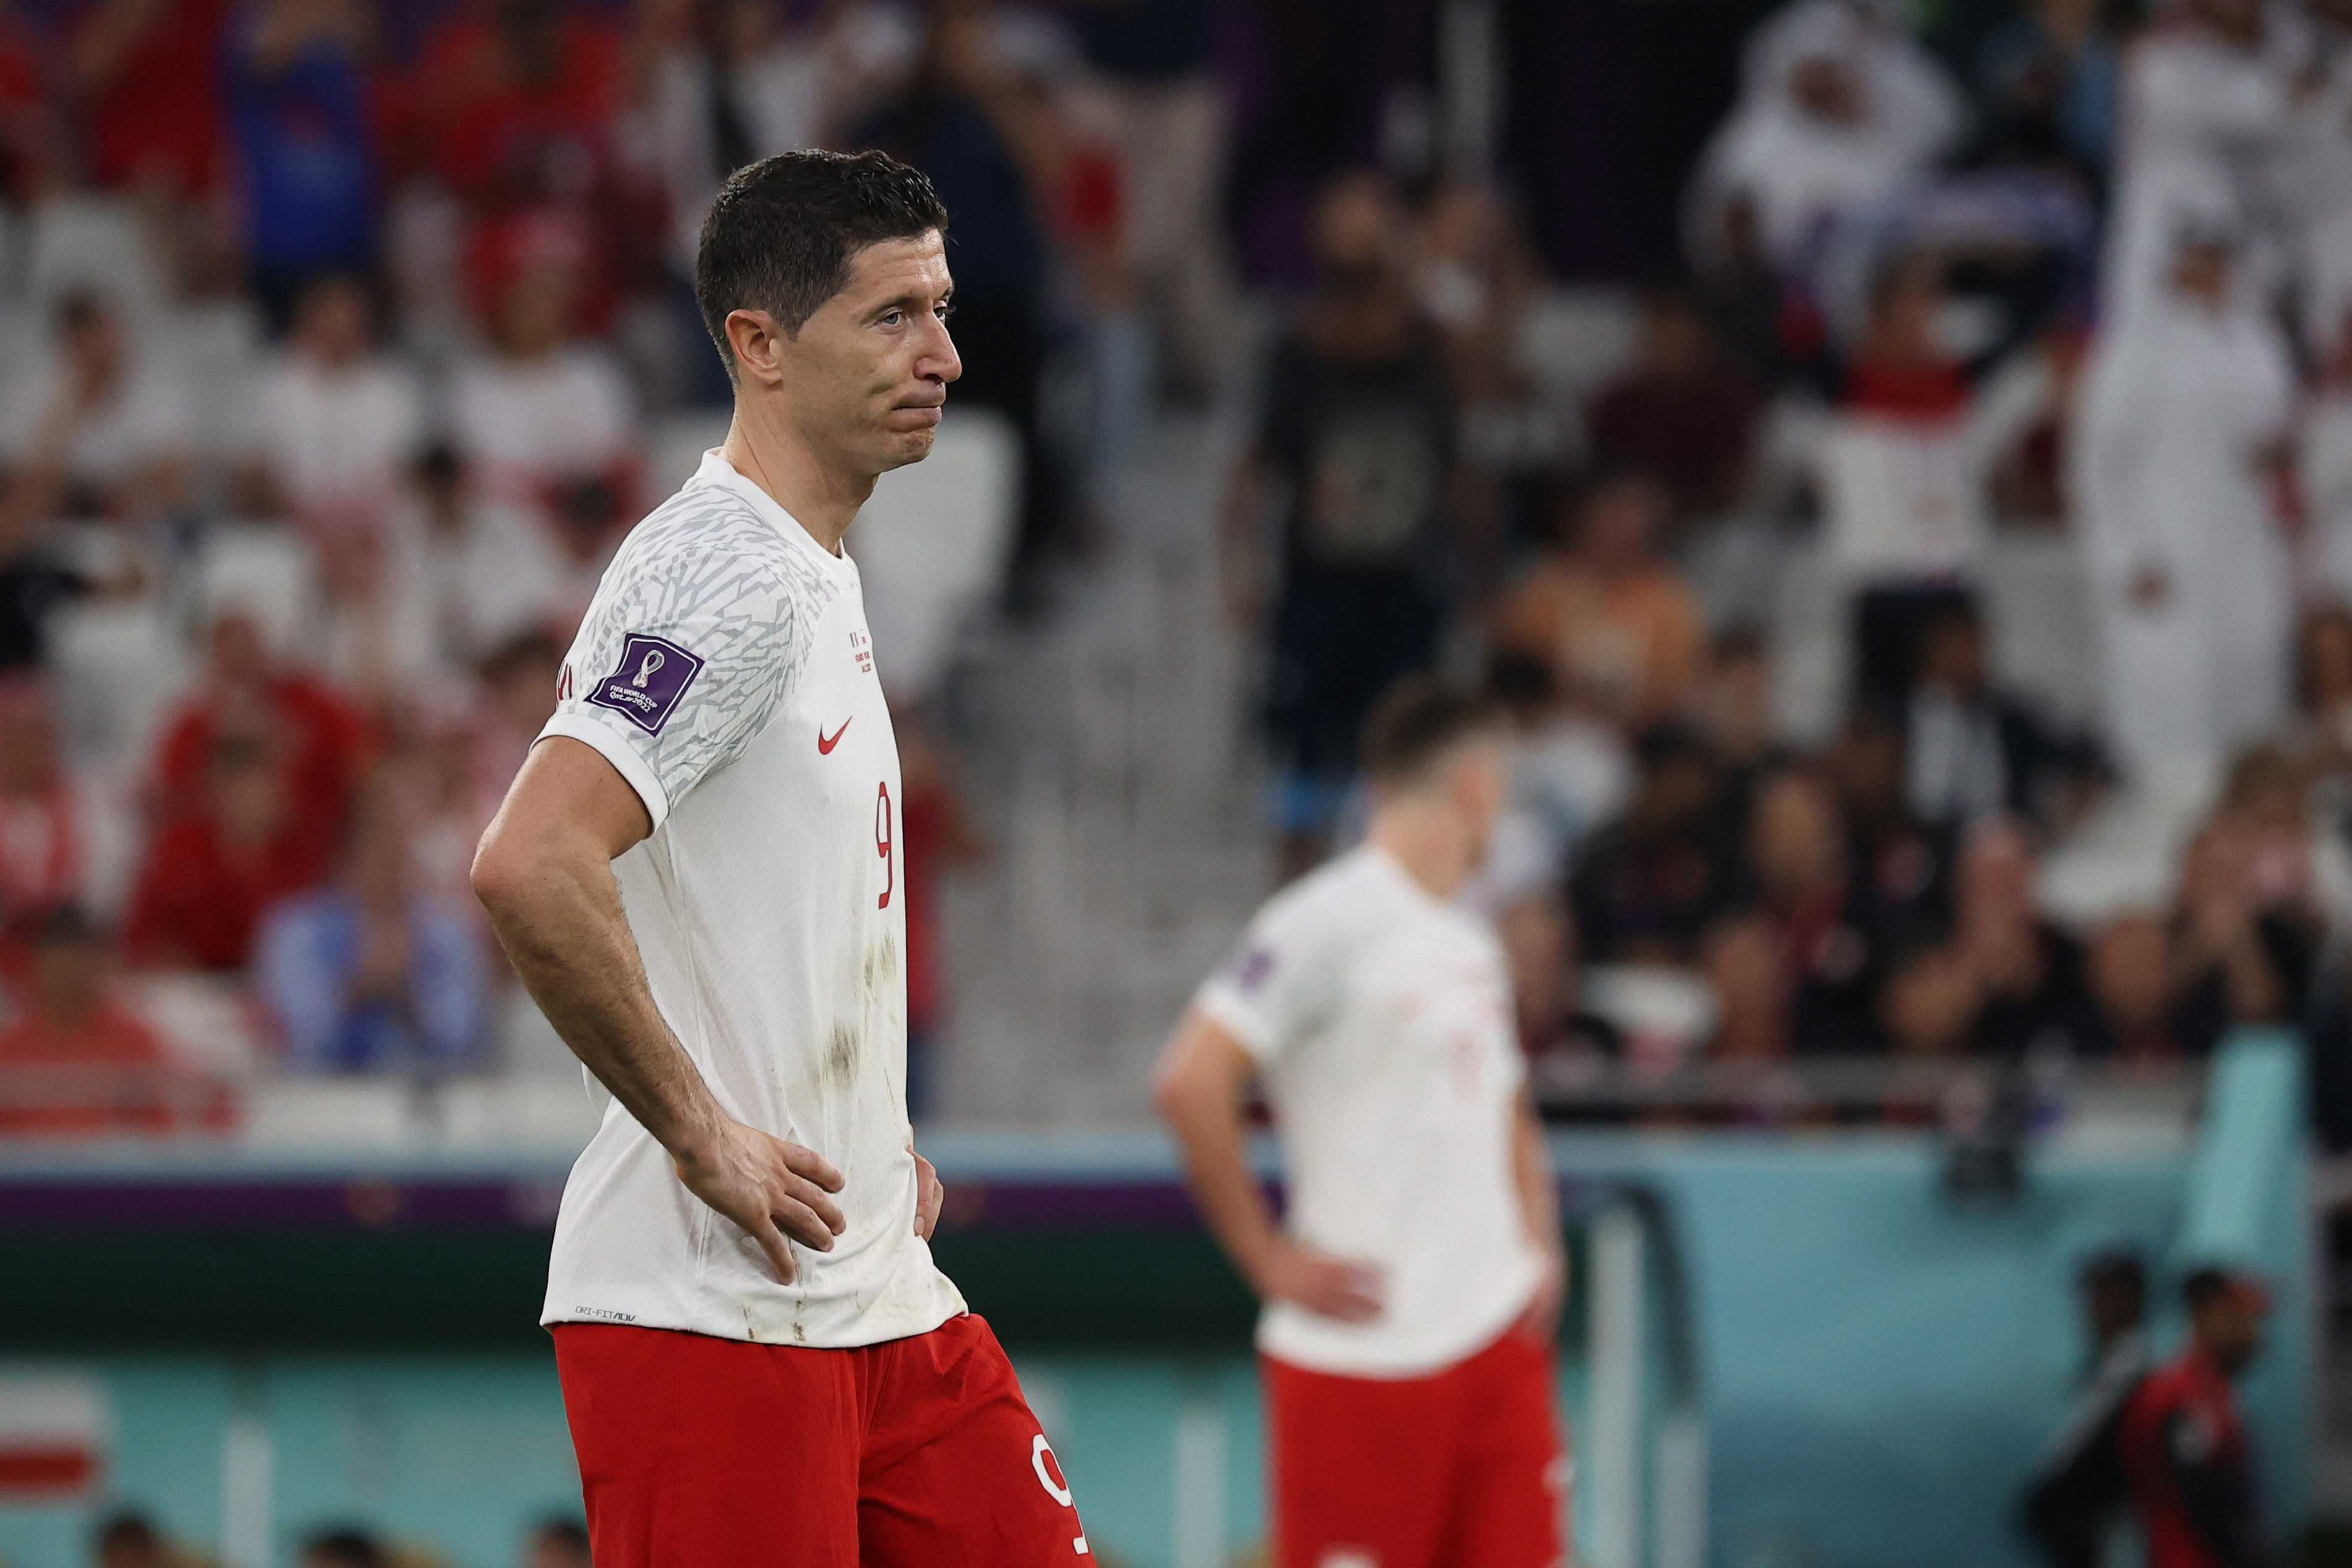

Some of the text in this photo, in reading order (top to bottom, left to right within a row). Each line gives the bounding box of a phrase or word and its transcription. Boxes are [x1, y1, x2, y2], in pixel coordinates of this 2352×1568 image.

[610, 685, 658, 708] FIFA WORLD CUP
[876, 781, 893, 910] 9
[1032, 1433, 1089, 1555] 9
